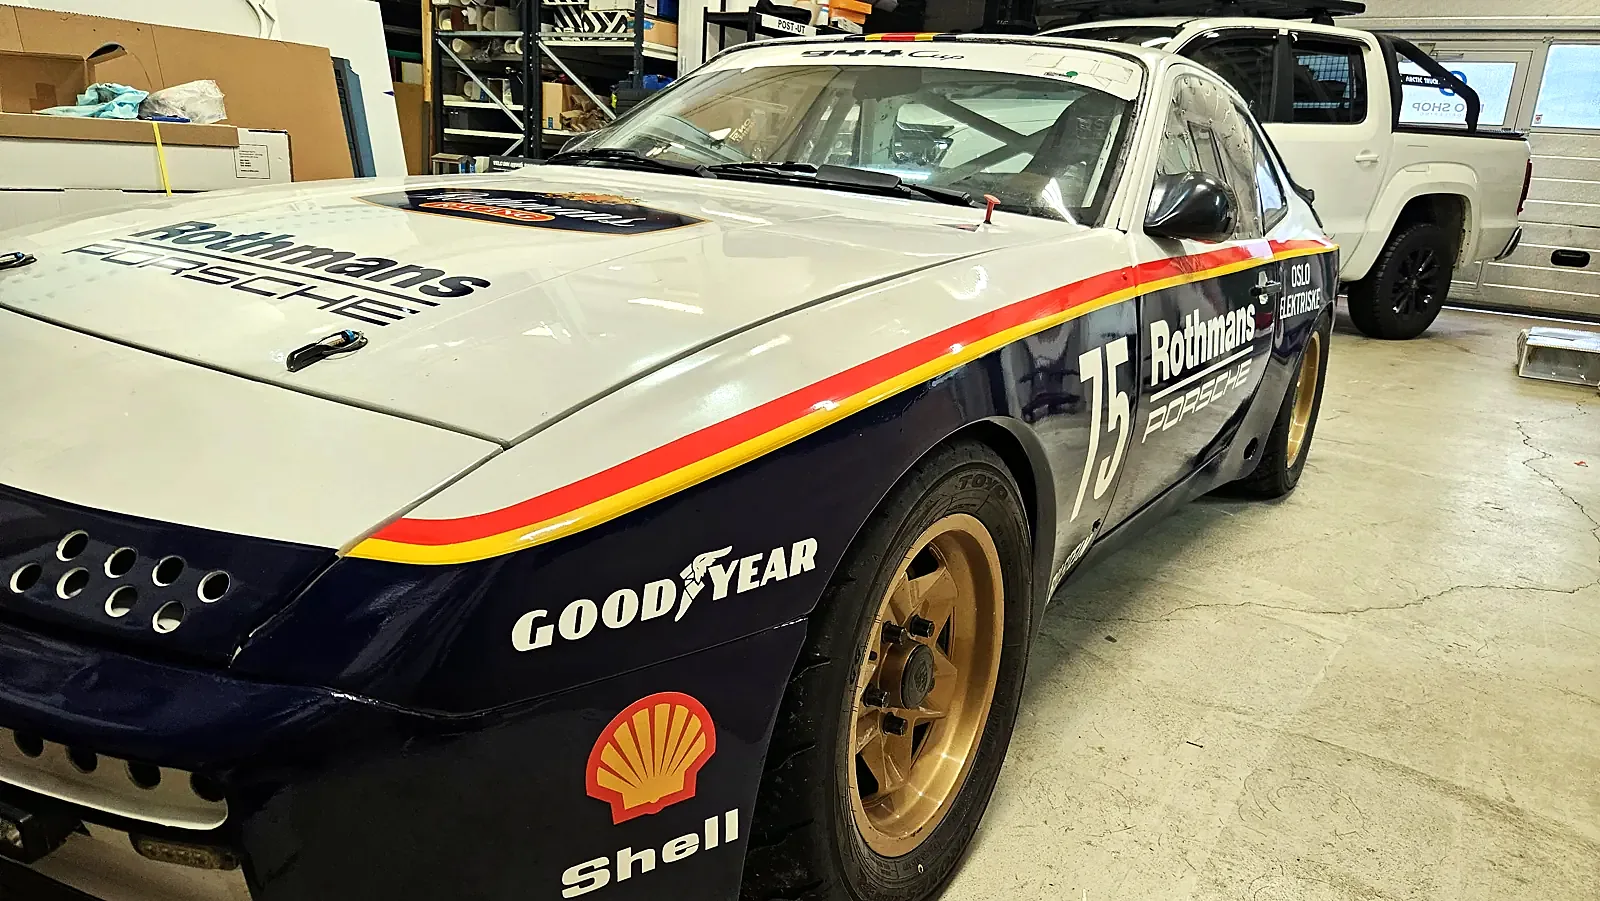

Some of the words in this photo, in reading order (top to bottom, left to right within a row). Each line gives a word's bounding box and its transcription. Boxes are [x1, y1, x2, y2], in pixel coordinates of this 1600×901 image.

[800, 49, 903, 58] 944
[907, 50, 965, 61] Cup
[431, 201, 543, 220] RACING
[62, 243, 421, 327] PORSCHE
[129, 220, 492, 299] Rothmans
[1291, 262, 1311, 288] OSLO
[1279, 287, 1321, 320] ELEKTRISKE
[1149, 302, 1257, 387] Rothmans
[1070, 336, 1129, 523] 75
[1141, 358, 1253, 444] PORSCHE
[957, 473, 1009, 502] TOYO
[511, 537, 819, 653] GOODYEAR
[560, 808, 740, 899] Shell
